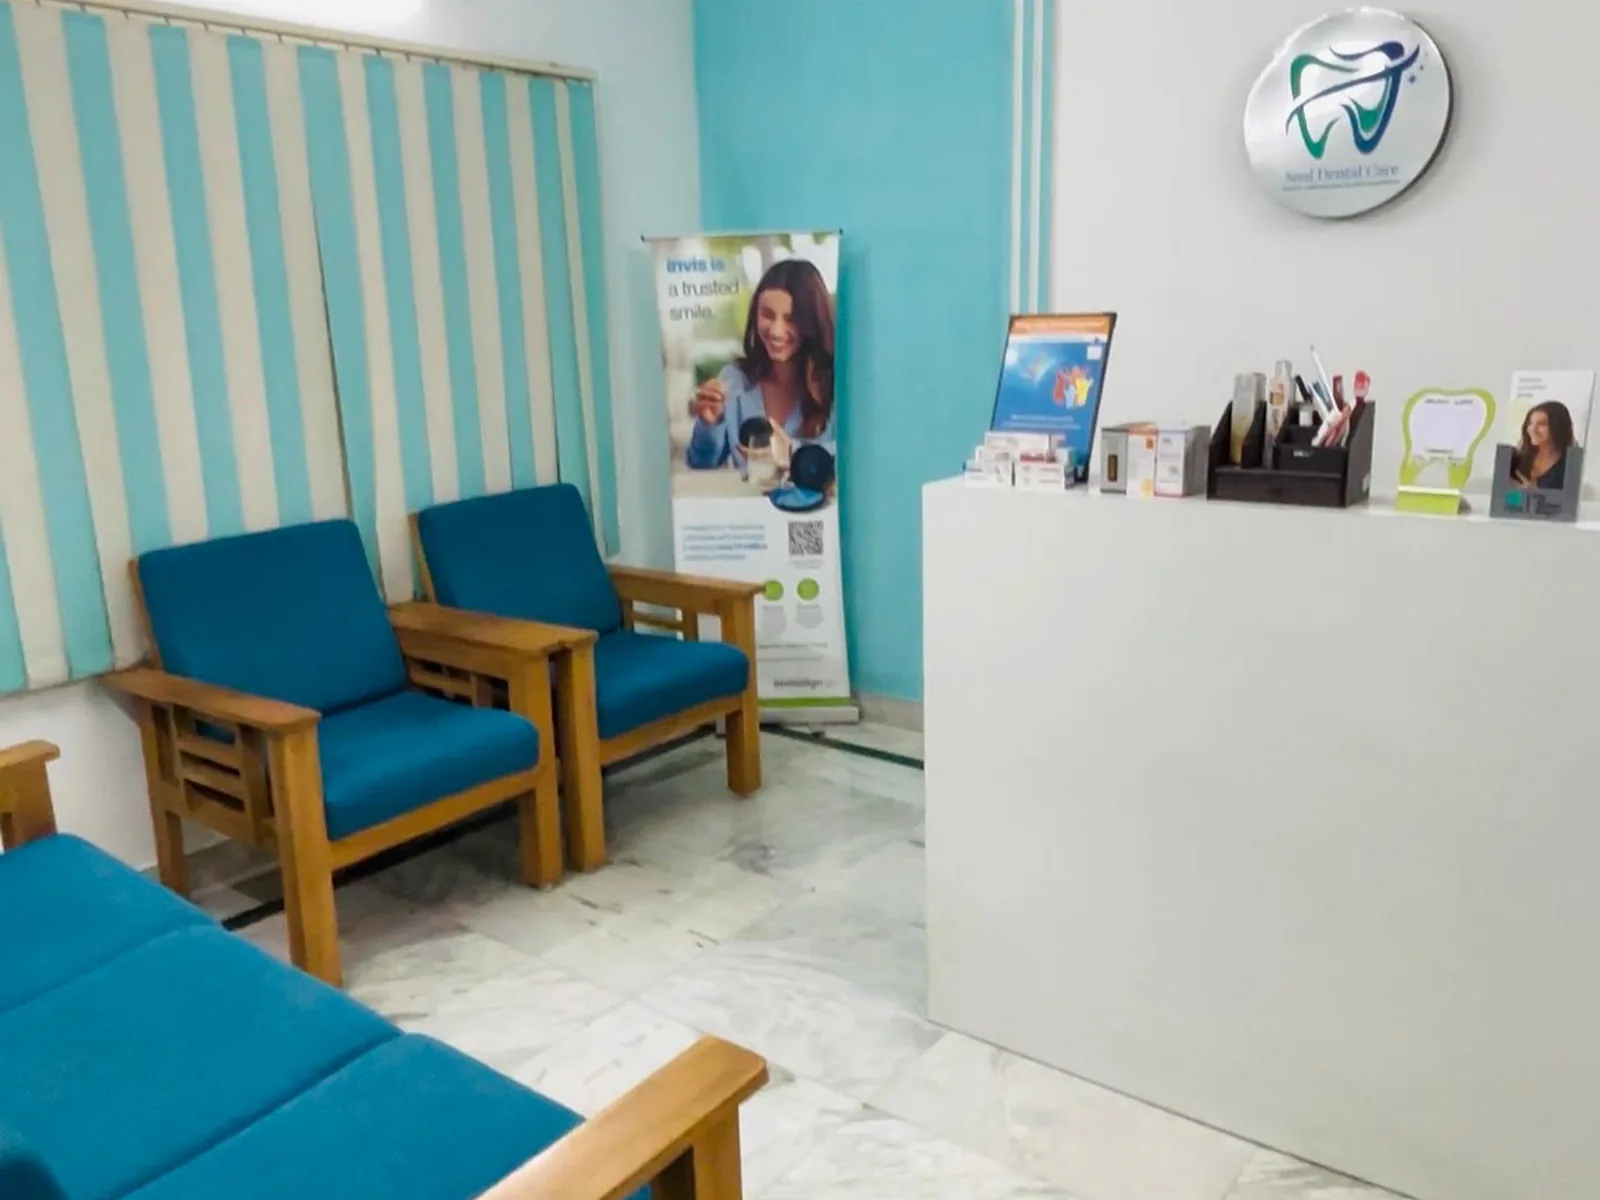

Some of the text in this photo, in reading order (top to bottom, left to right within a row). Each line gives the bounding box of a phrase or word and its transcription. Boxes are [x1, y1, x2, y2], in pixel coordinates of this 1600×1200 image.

[1317, 165, 1362, 181] Dental
[1366, 164, 1399, 178] Care
[666, 257, 725, 272] invis is
[668, 279, 739, 296] a trusted
